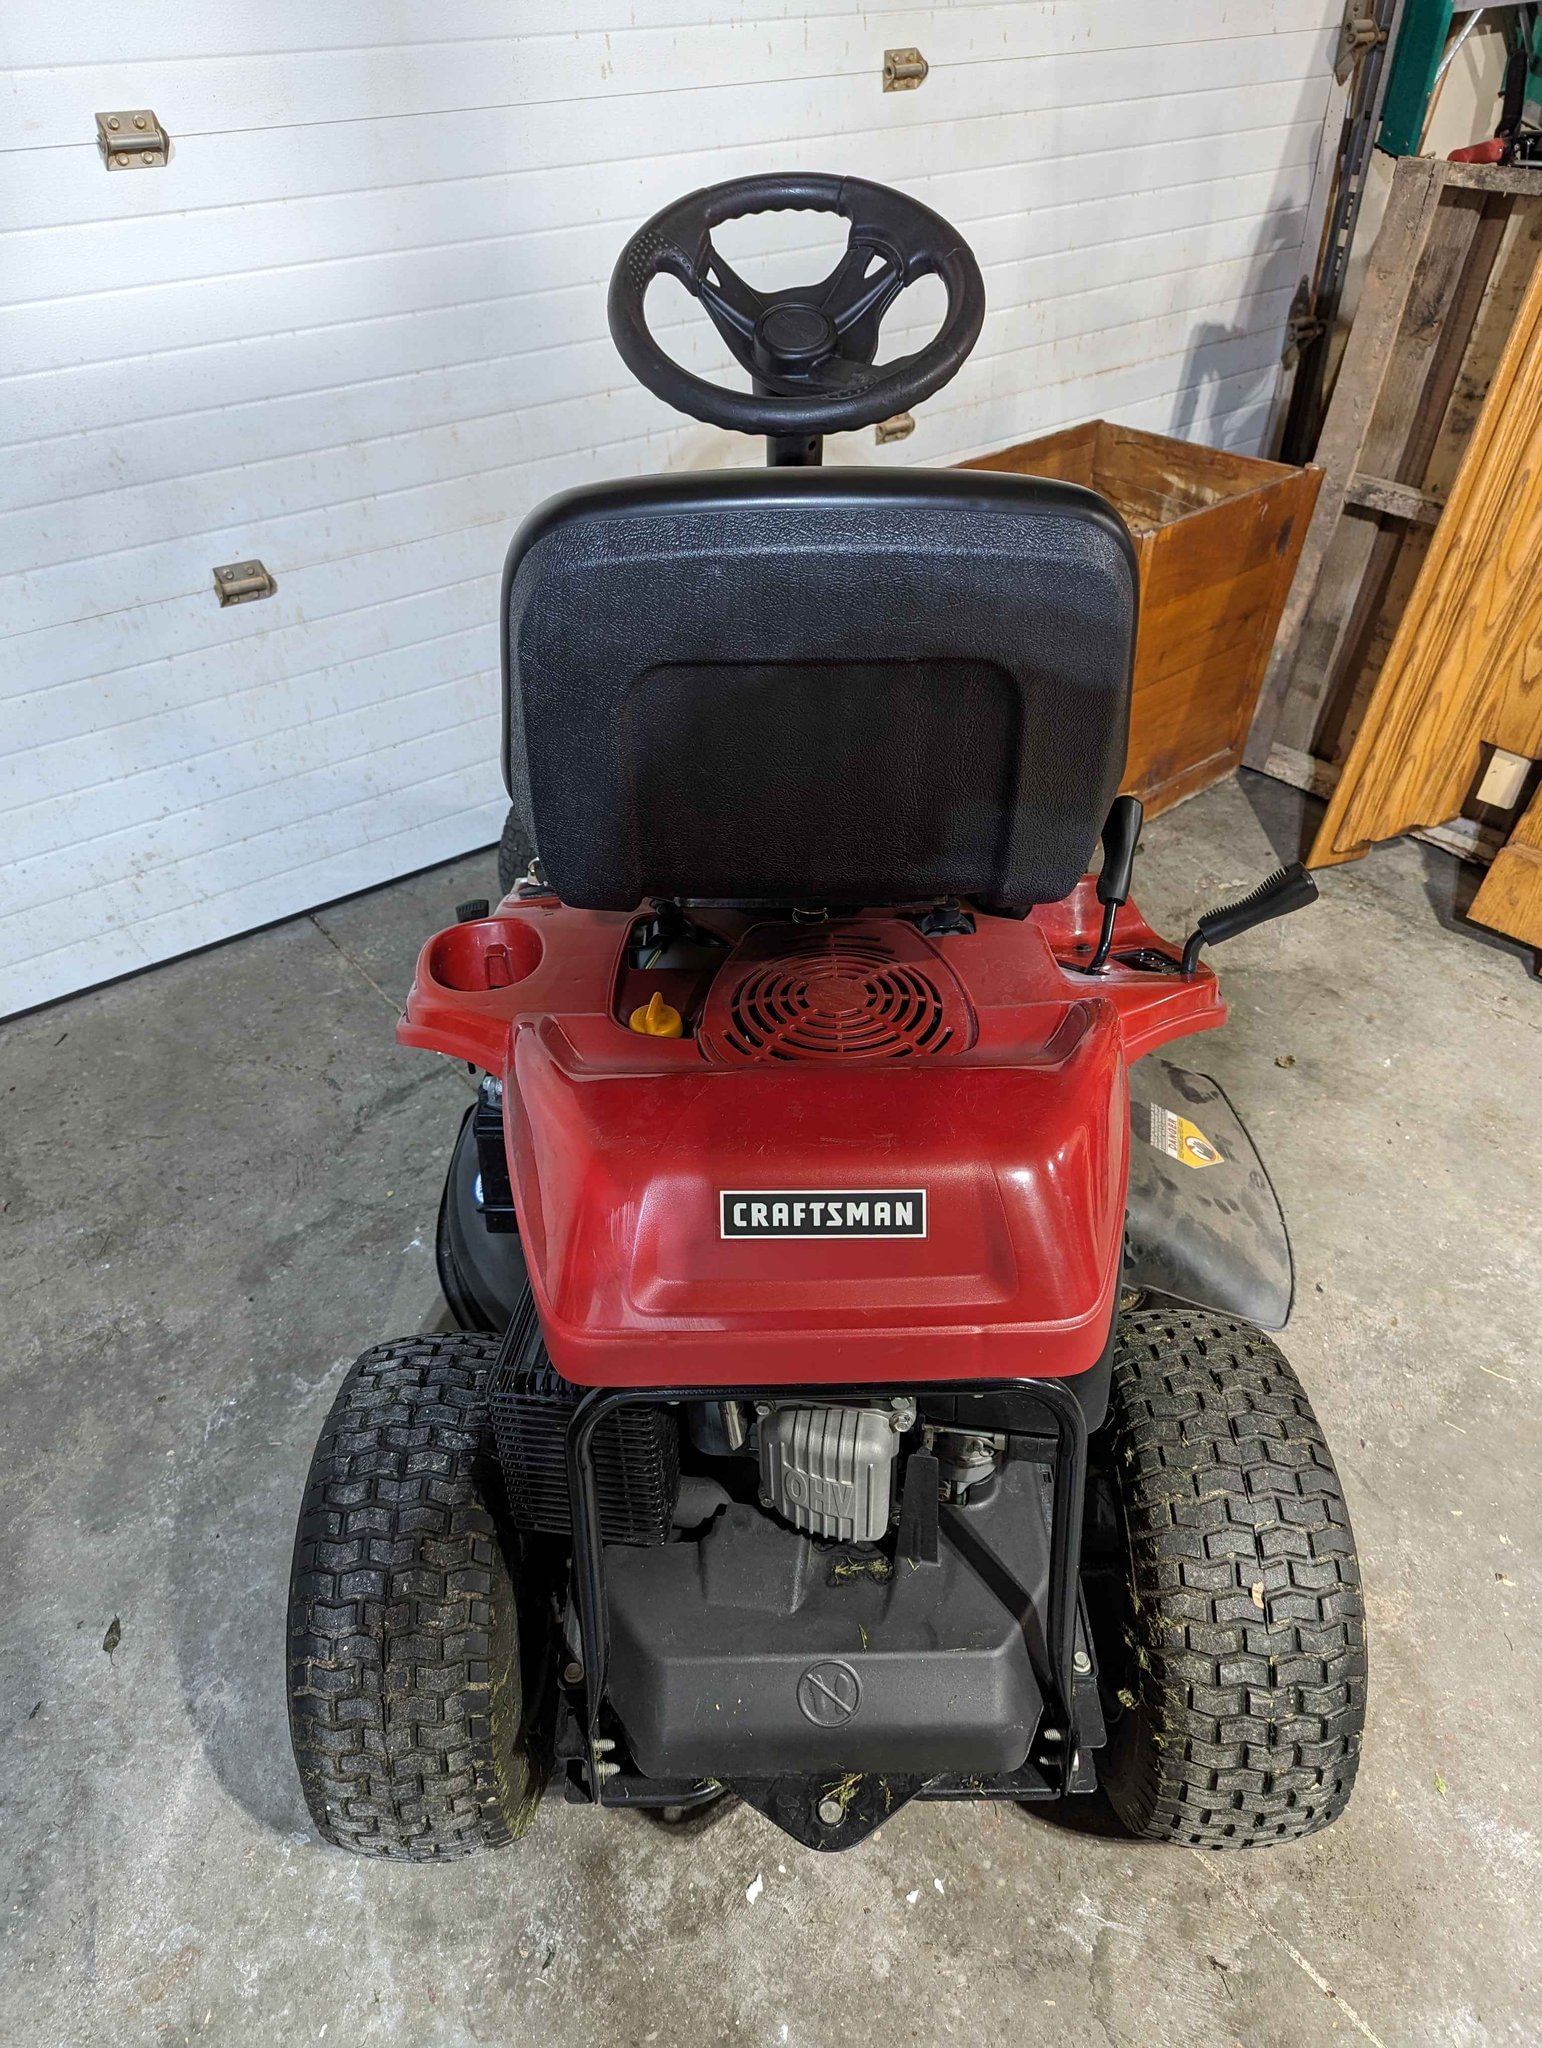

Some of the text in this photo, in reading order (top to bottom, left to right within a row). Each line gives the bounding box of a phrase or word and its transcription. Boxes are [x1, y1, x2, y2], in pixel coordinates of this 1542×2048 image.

[1168, 1118, 1177, 1150] DANGER
[733, 1201, 913, 1227] CRAFTSMAN
[785, 1470, 854, 1517] OHV
